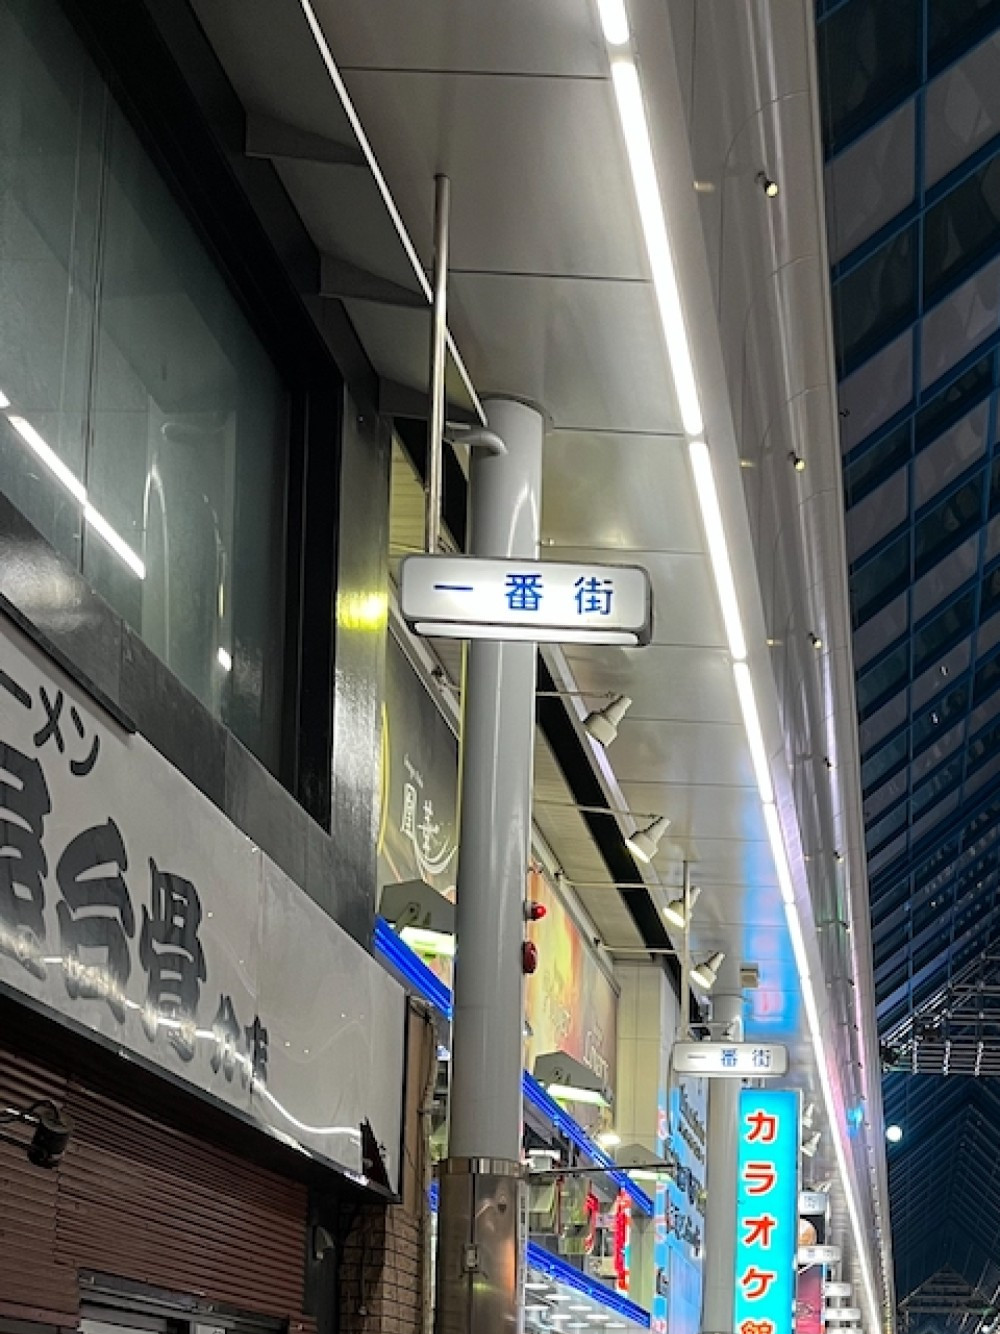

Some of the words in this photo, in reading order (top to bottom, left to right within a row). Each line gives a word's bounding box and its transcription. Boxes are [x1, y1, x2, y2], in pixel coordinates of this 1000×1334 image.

[433, 574, 614, 617] 一番街
[687, 1048, 771, 1068] 一番街
